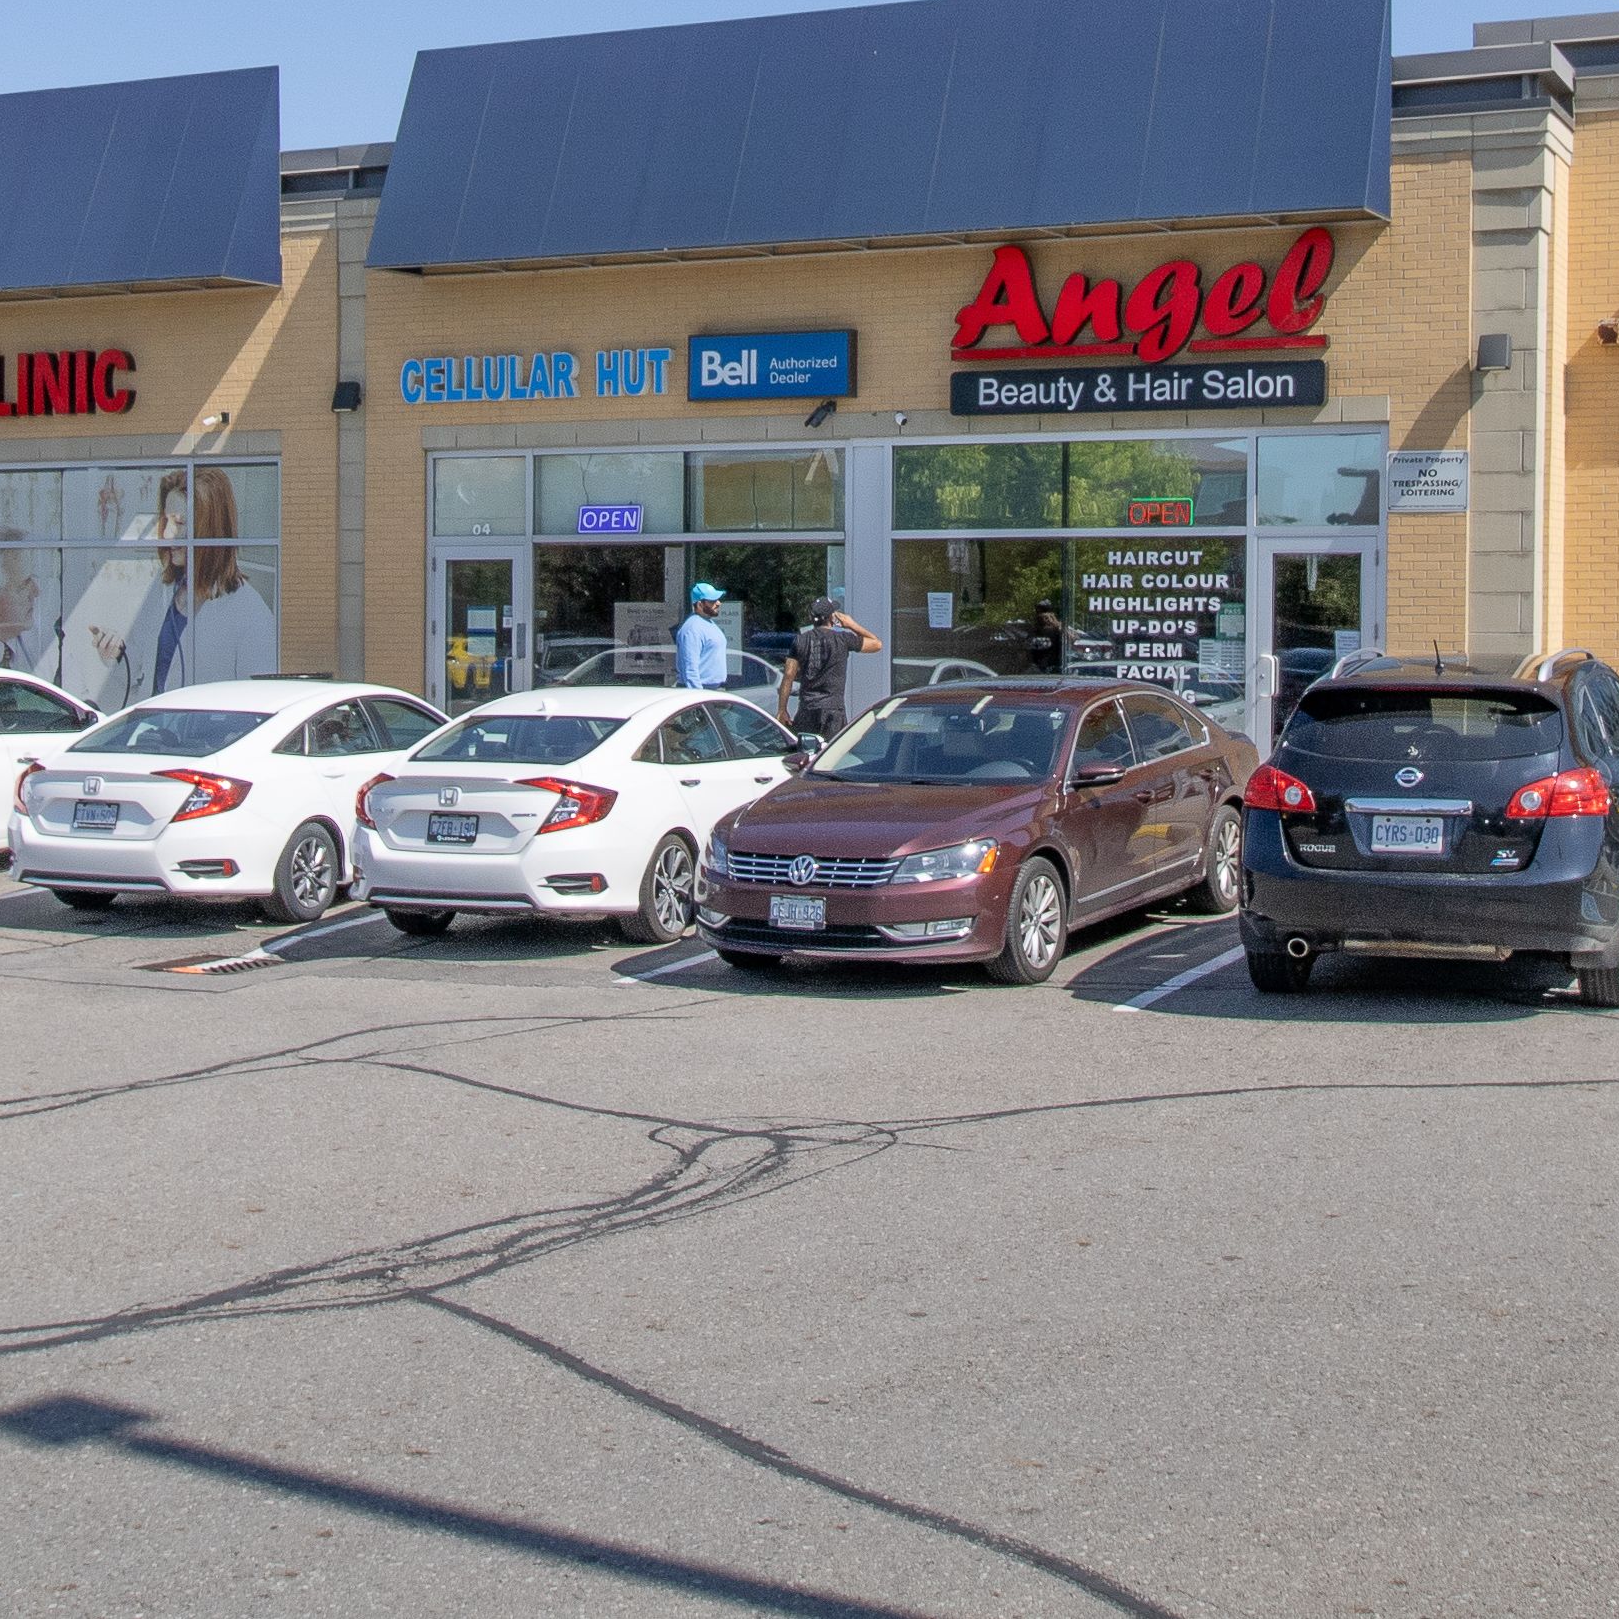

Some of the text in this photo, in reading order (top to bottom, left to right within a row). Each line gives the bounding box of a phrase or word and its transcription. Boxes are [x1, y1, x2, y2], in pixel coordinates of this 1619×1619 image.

[951, 226, 1335, 364] Angel
[700, 348, 758, 387] Bell
[769, 355, 838, 371] Authorized
[399, 348, 675, 404] CELLULAR HUT
[769, 371, 812, 385] Dealer
[978, 369, 1295, 410] Beauty & Hair Salon
[1425, 456, 1464, 464] Property
[1418, 469, 1437, 478] NO
[1401, 489, 1454, 497] LOITERING
[582, 510, 638, 528] OPEN
[1129, 502, 1190, 524] OPEN
[473, 523, 491, 535] 04
[1108, 551, 1203, 565] HAIRCUT
[1083, 574, 1229, 589] HAIR COLOUR
[1089, 596, 1221, 612] HIGHLIGHTS
[1112, 619, 1197, 634] UP-DO'S
[1125, 643, 1183, 658] PERM
[1117, 665, 1191, 679] FACIAL
[1375, 825, 1407, 842] CYRS
[1299, 844, 1336, 853] ROGUE
[1497, 849, 1516, 858] SV
